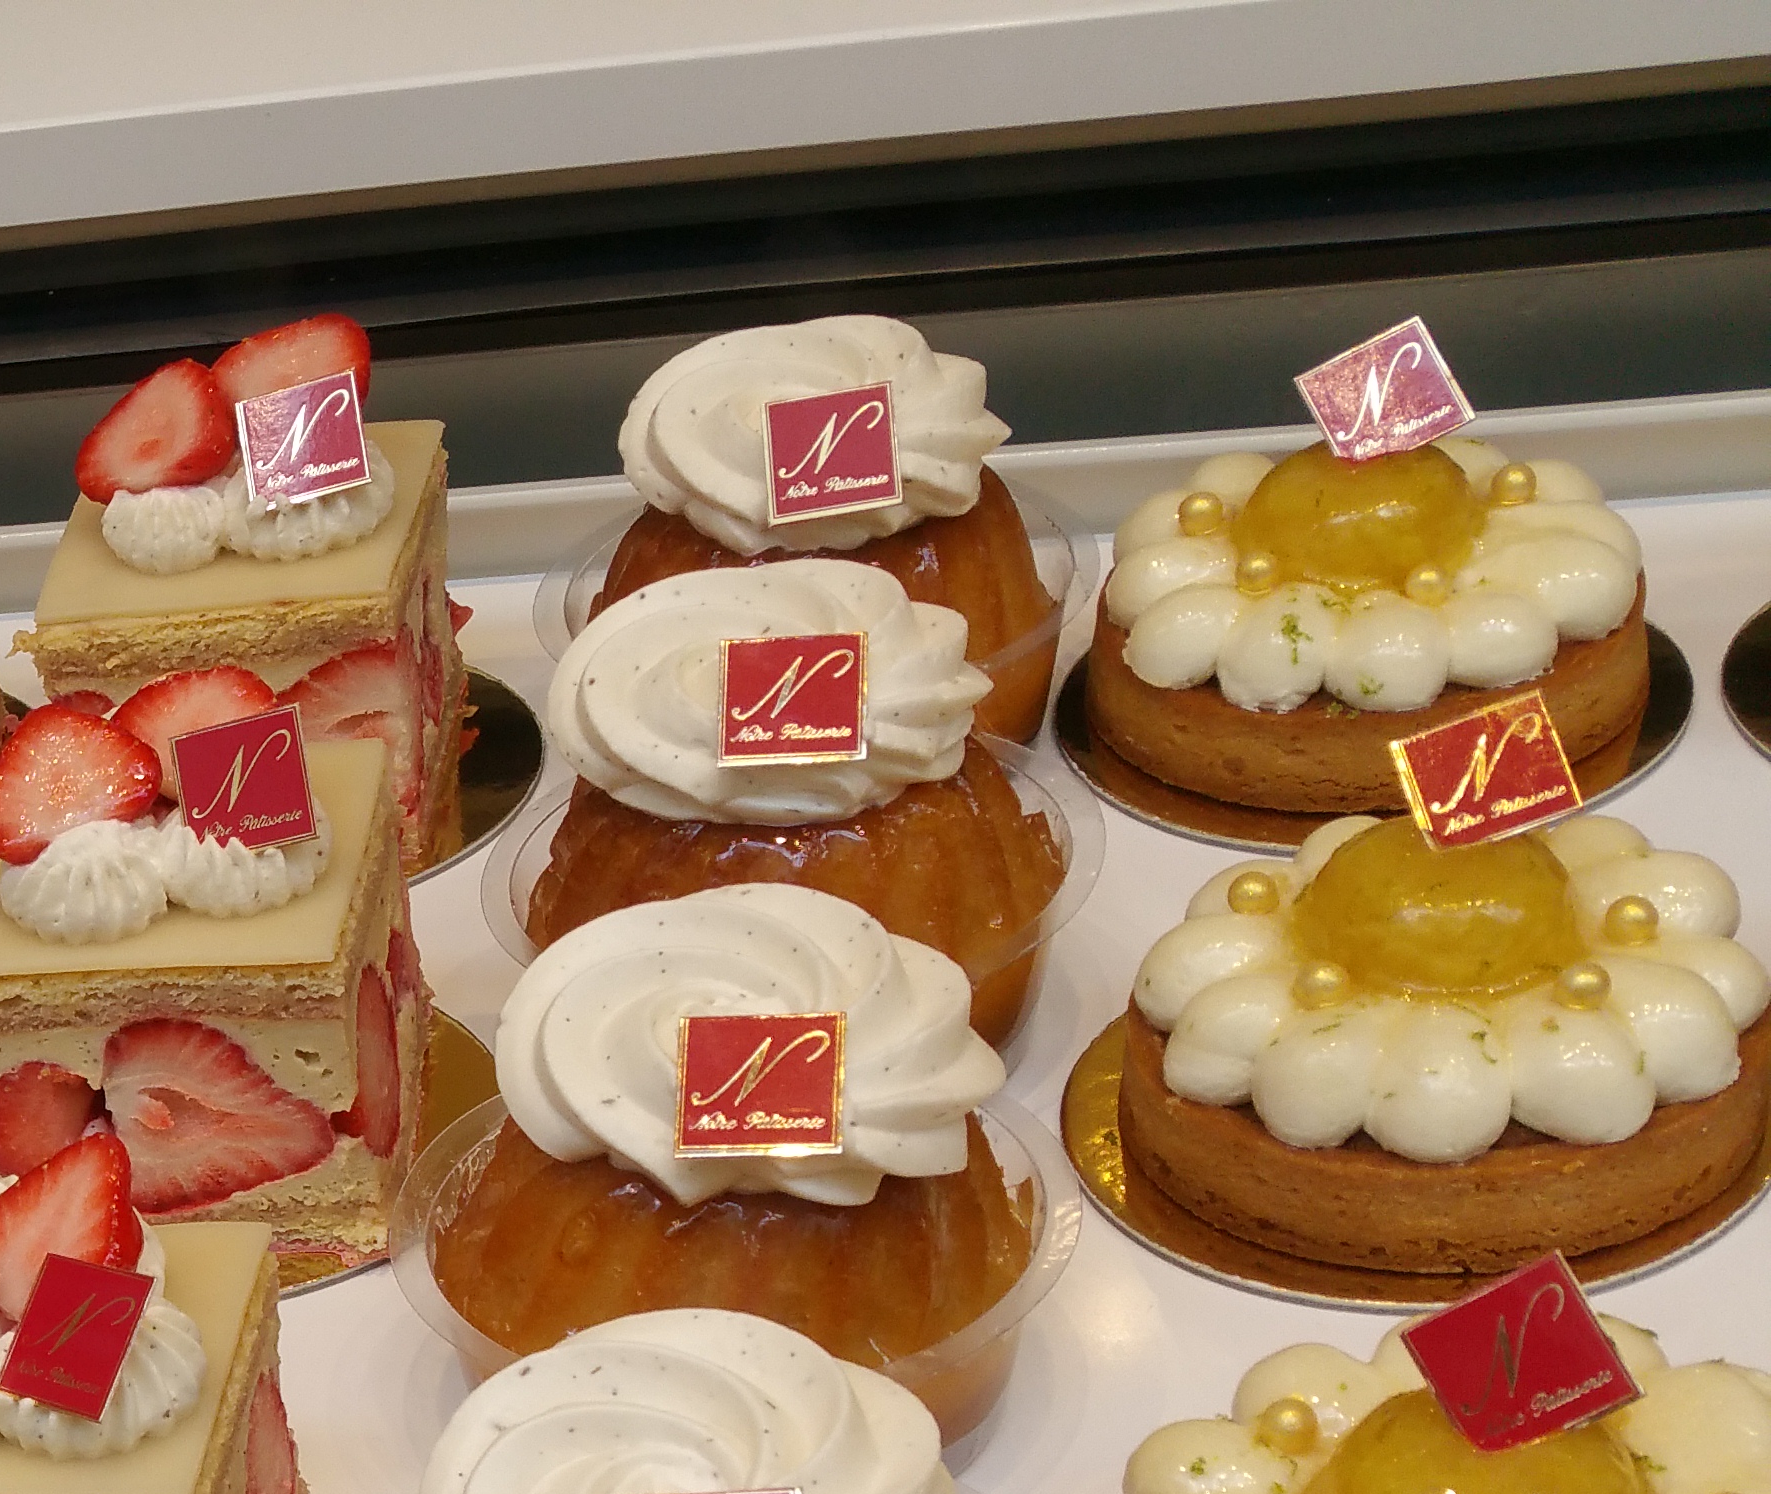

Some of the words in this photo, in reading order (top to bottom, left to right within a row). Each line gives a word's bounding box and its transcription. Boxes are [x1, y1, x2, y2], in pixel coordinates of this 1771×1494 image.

[256, 389, 350, 470] N
[1336, 342, 1422, 443] N
[778, 401, 884, 480] N
[731, 649, 855, 721] N
[192, 729, 292, 819] N
[1429, 712, 1543, 815] N
[690, 1030, 830, 1107] N
[1460, 1282, 1565, 1416] N
